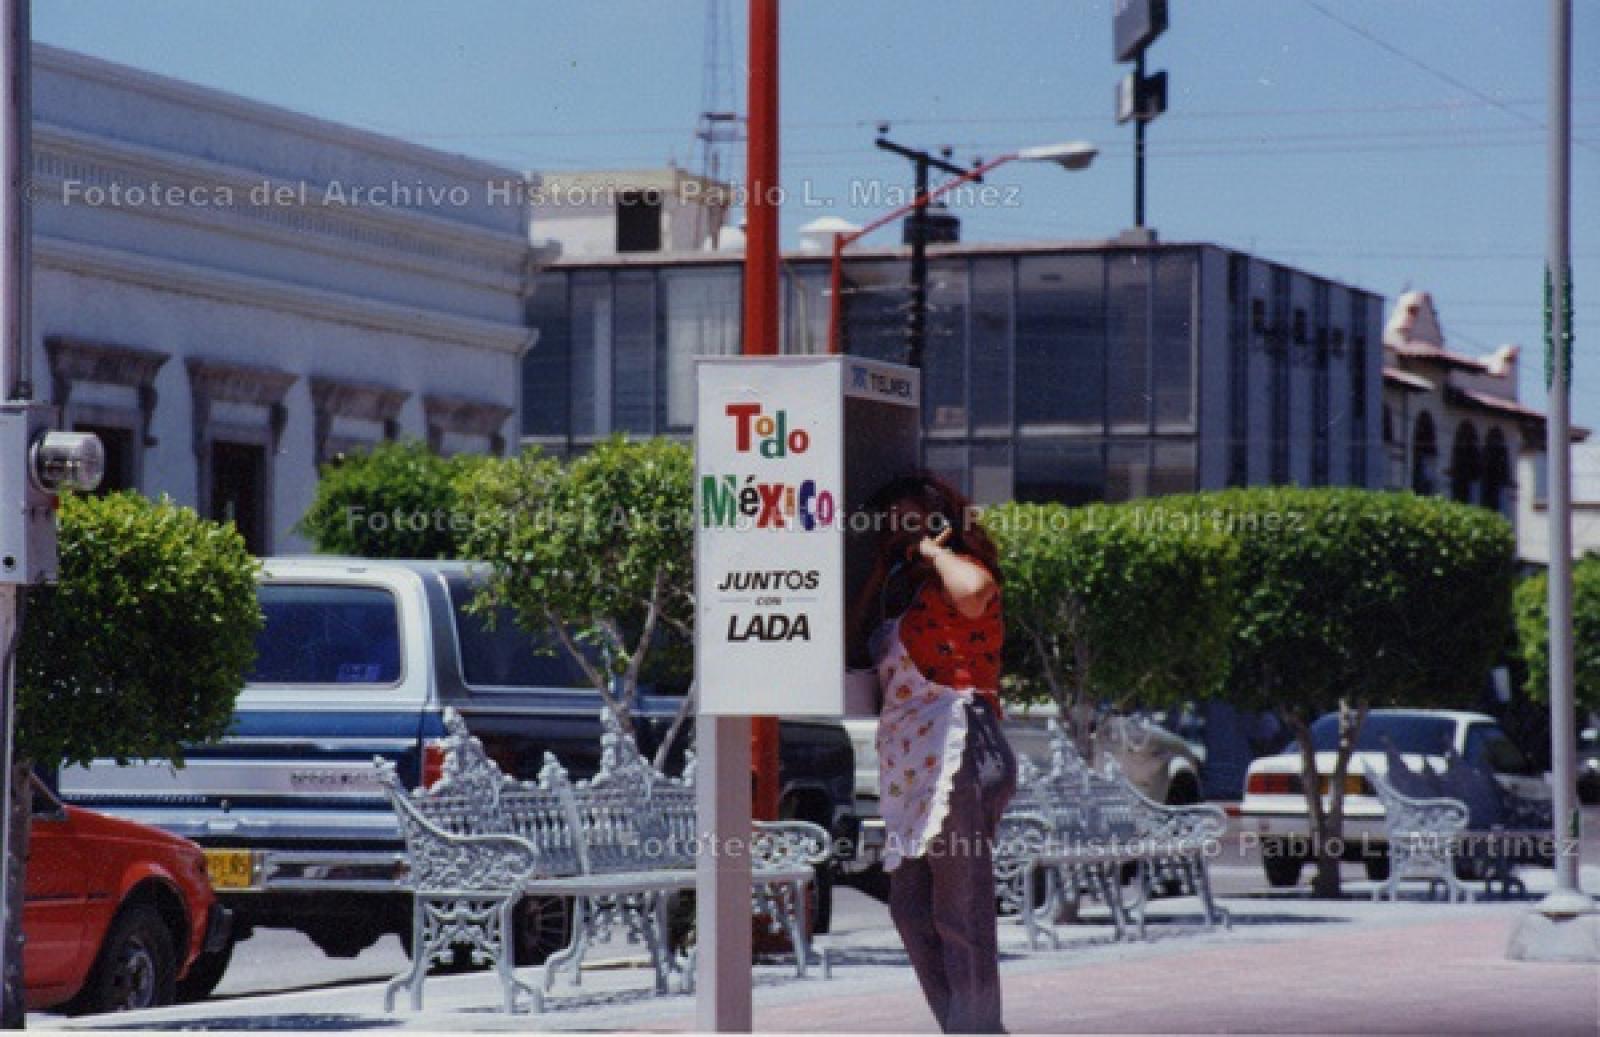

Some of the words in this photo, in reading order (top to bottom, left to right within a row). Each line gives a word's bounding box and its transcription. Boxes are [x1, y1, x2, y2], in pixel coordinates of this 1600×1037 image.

[725, 402, 810, 459] Todo
[701, 473, 835, 532] México
[718, 570, 821, 591] JUNTOS
[727, 612, 812, 642] LADA
